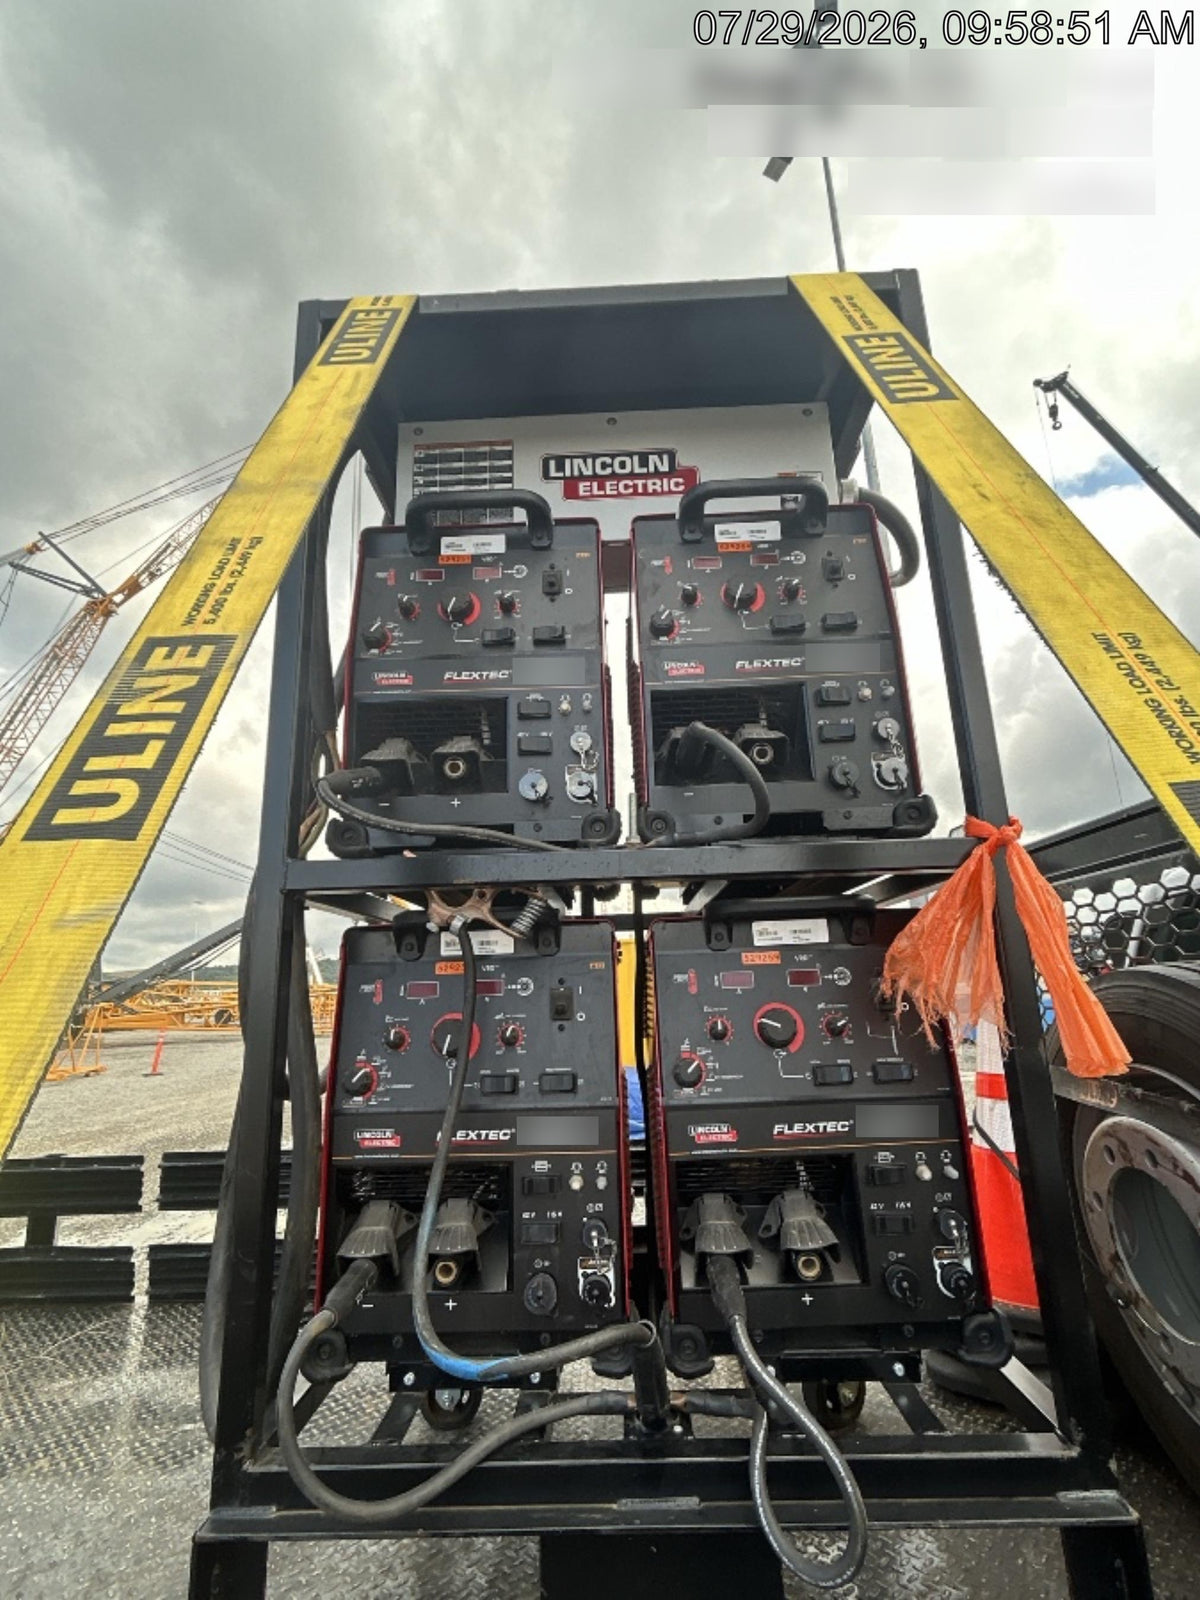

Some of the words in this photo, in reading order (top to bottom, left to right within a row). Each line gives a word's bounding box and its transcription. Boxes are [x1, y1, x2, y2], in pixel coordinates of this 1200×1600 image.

[329, 310, 393, 362] ULINE
[853, 335, 940, 399] ULINE
[549, 454, 670, 478] LINCOLN
[578, 477, 686, 497] ELECTRIC
[1091, 632, 1125, 660] LIMIT
[735, 657, 802, 670] FLEXTEC
[1116, 662, 1153, 695] LOAD
[1174, 694, 1200, 717] lbs.
[51, 643, 217, 826] ULINE
[1143, 698, 1200, 765] WORKING
[773, 1121, 850, 1135] FLEXTEC
